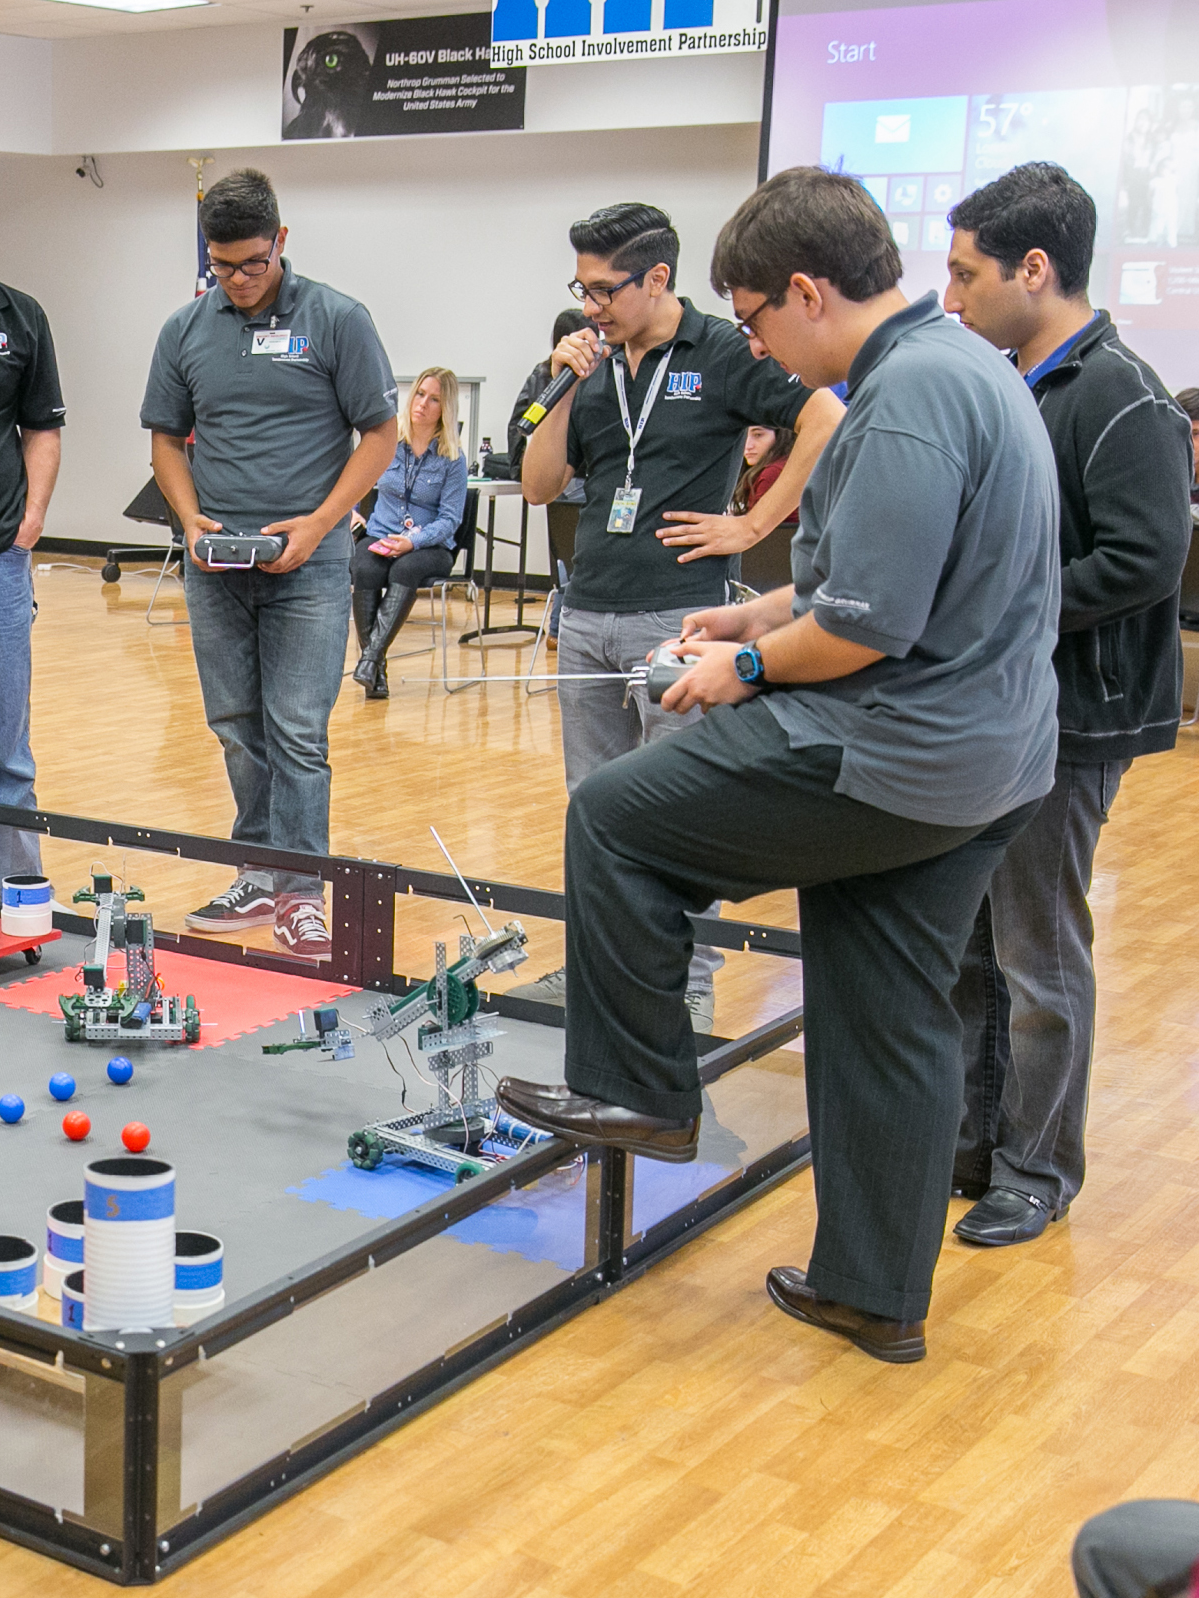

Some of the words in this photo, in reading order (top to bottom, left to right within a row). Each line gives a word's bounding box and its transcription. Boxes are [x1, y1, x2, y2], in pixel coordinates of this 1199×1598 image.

[491, 44, 523, 66] High
[529, 41, 575, 61] School
[581, 35, 673, 57] Involvement
[679, 28, 767, 51] Partnership
[826, 40, 876, 65] Start
[385, 50, 435, 66] UH-60V
[438, 47, 473, 63] Black
[475, 47, 491, 60] Ha
[387, 78, 421, 88] Northrop
[422, 75, 460, 86] Grumman
[461, 73, 495, 84] Selected
[496, 72, 505, 82] to
[373, 89, 413, 101] Modernize
[413, 88, 434, 98] Black
[435, 86, 457, 98] Hawk
[457, 84, 487, 96] Cockpit
[488, 84, 500, 94] for
[501, 84, 515, 93] the
[403, 100, 429, 111] United
[429, 98, 455, 110] States
[456, 98, 478, 109] Army
[667, 372, 702, 393] HIP
[16, 890, 23, 904] 1
[106, 1195, 120, 1218] 5
[68, 1304, 75, 1322] 1
